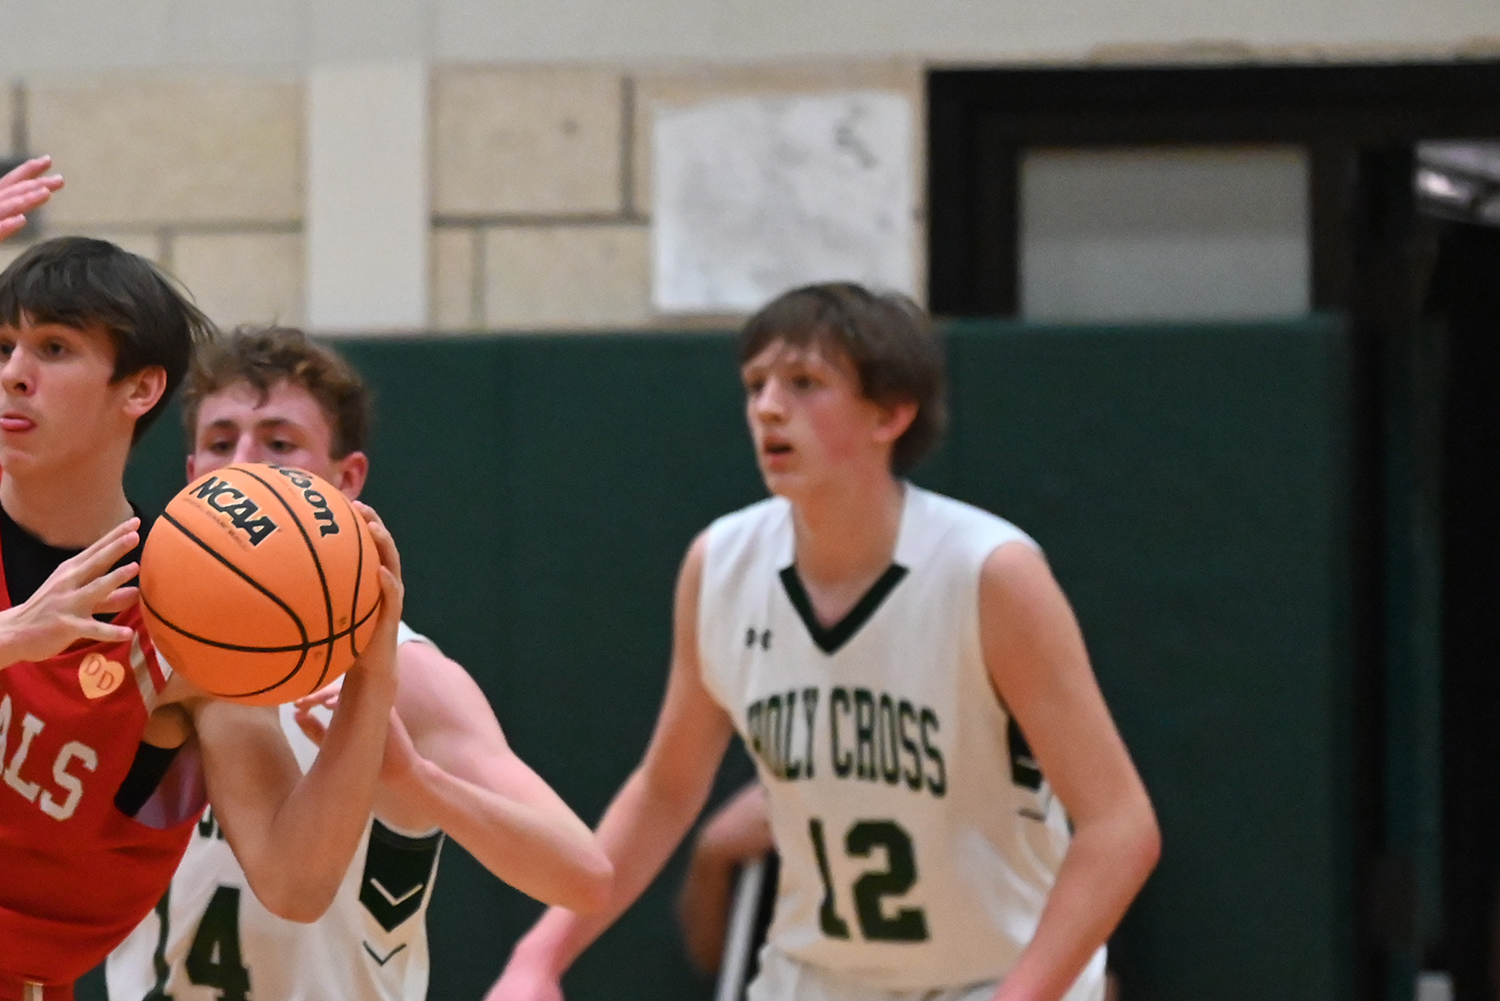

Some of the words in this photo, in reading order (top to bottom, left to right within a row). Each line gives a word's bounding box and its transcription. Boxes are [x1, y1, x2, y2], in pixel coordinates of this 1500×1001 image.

[188, 475, 279, 546] NCAA
[830, 686, 947, 798] CROSS
[808, 818, 930, 942] 12
